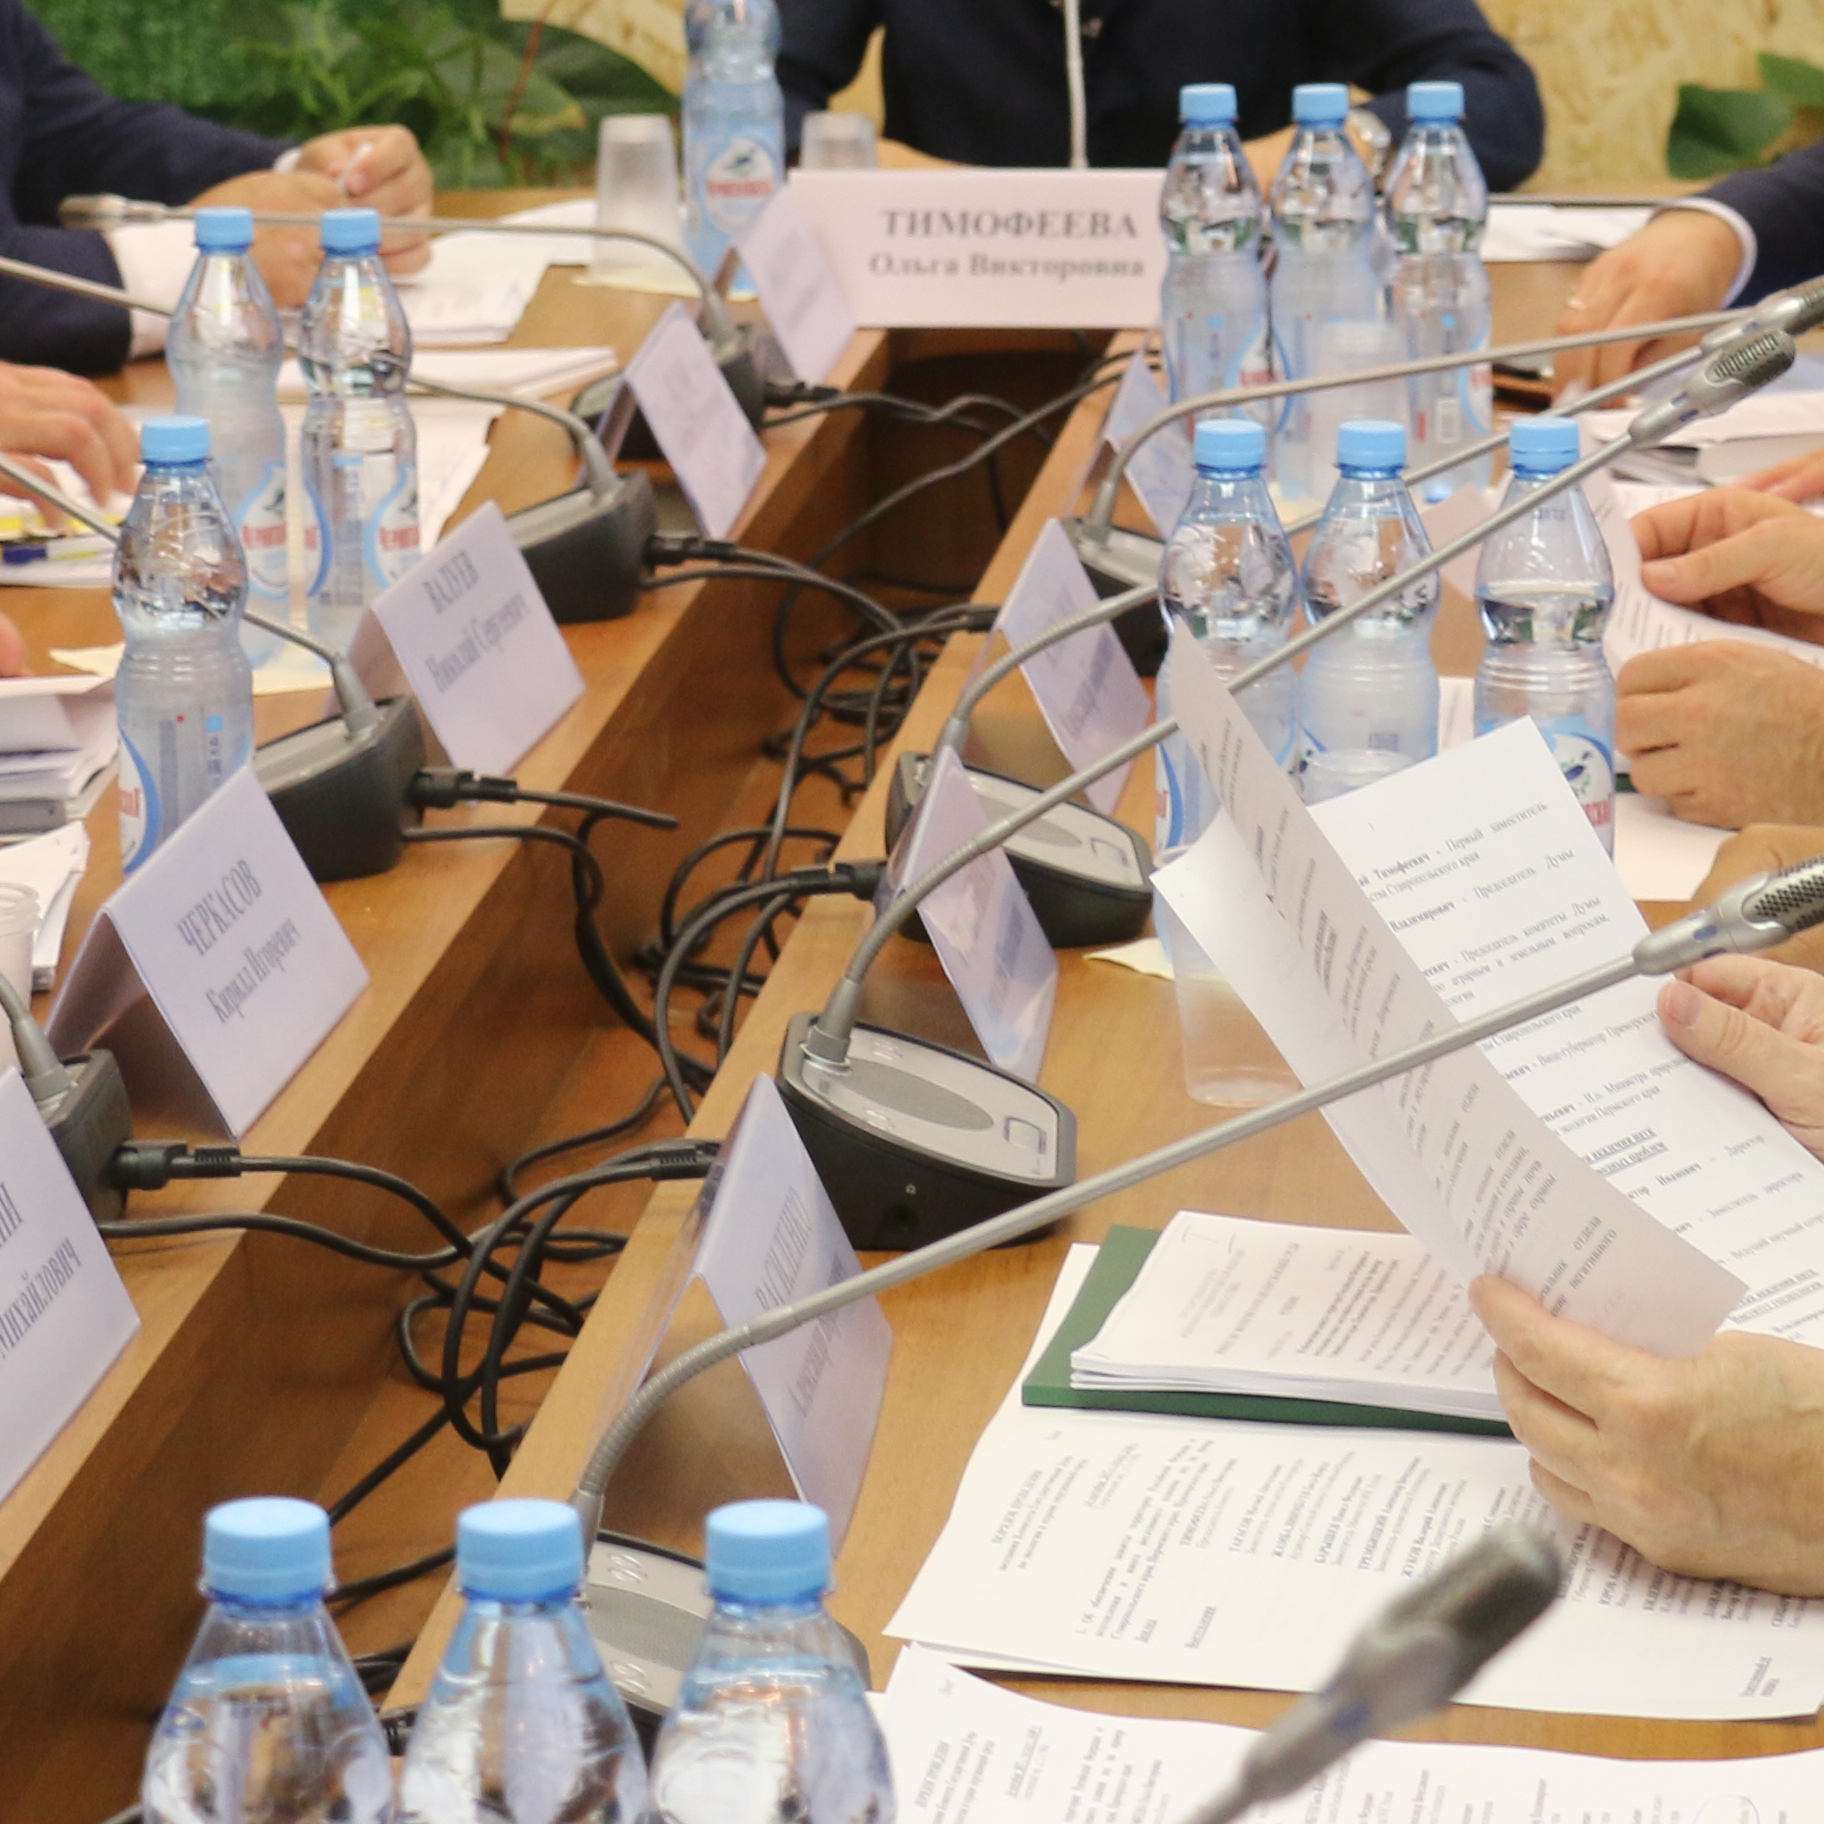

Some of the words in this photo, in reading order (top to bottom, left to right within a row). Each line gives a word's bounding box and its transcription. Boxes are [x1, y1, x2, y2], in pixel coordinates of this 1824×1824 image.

[882, 209, 1138, 238] ТИМОФЕЕВА
[869, 255, 958, 277] Ольга
[969, 254, 1145, 282] Викторовна
[177, 860, 261, 955] ЧЕРКАСОВ
[1573, 1216, 1602, 1250] отдела
[1569, 1229, 1617, 1290] негативного
